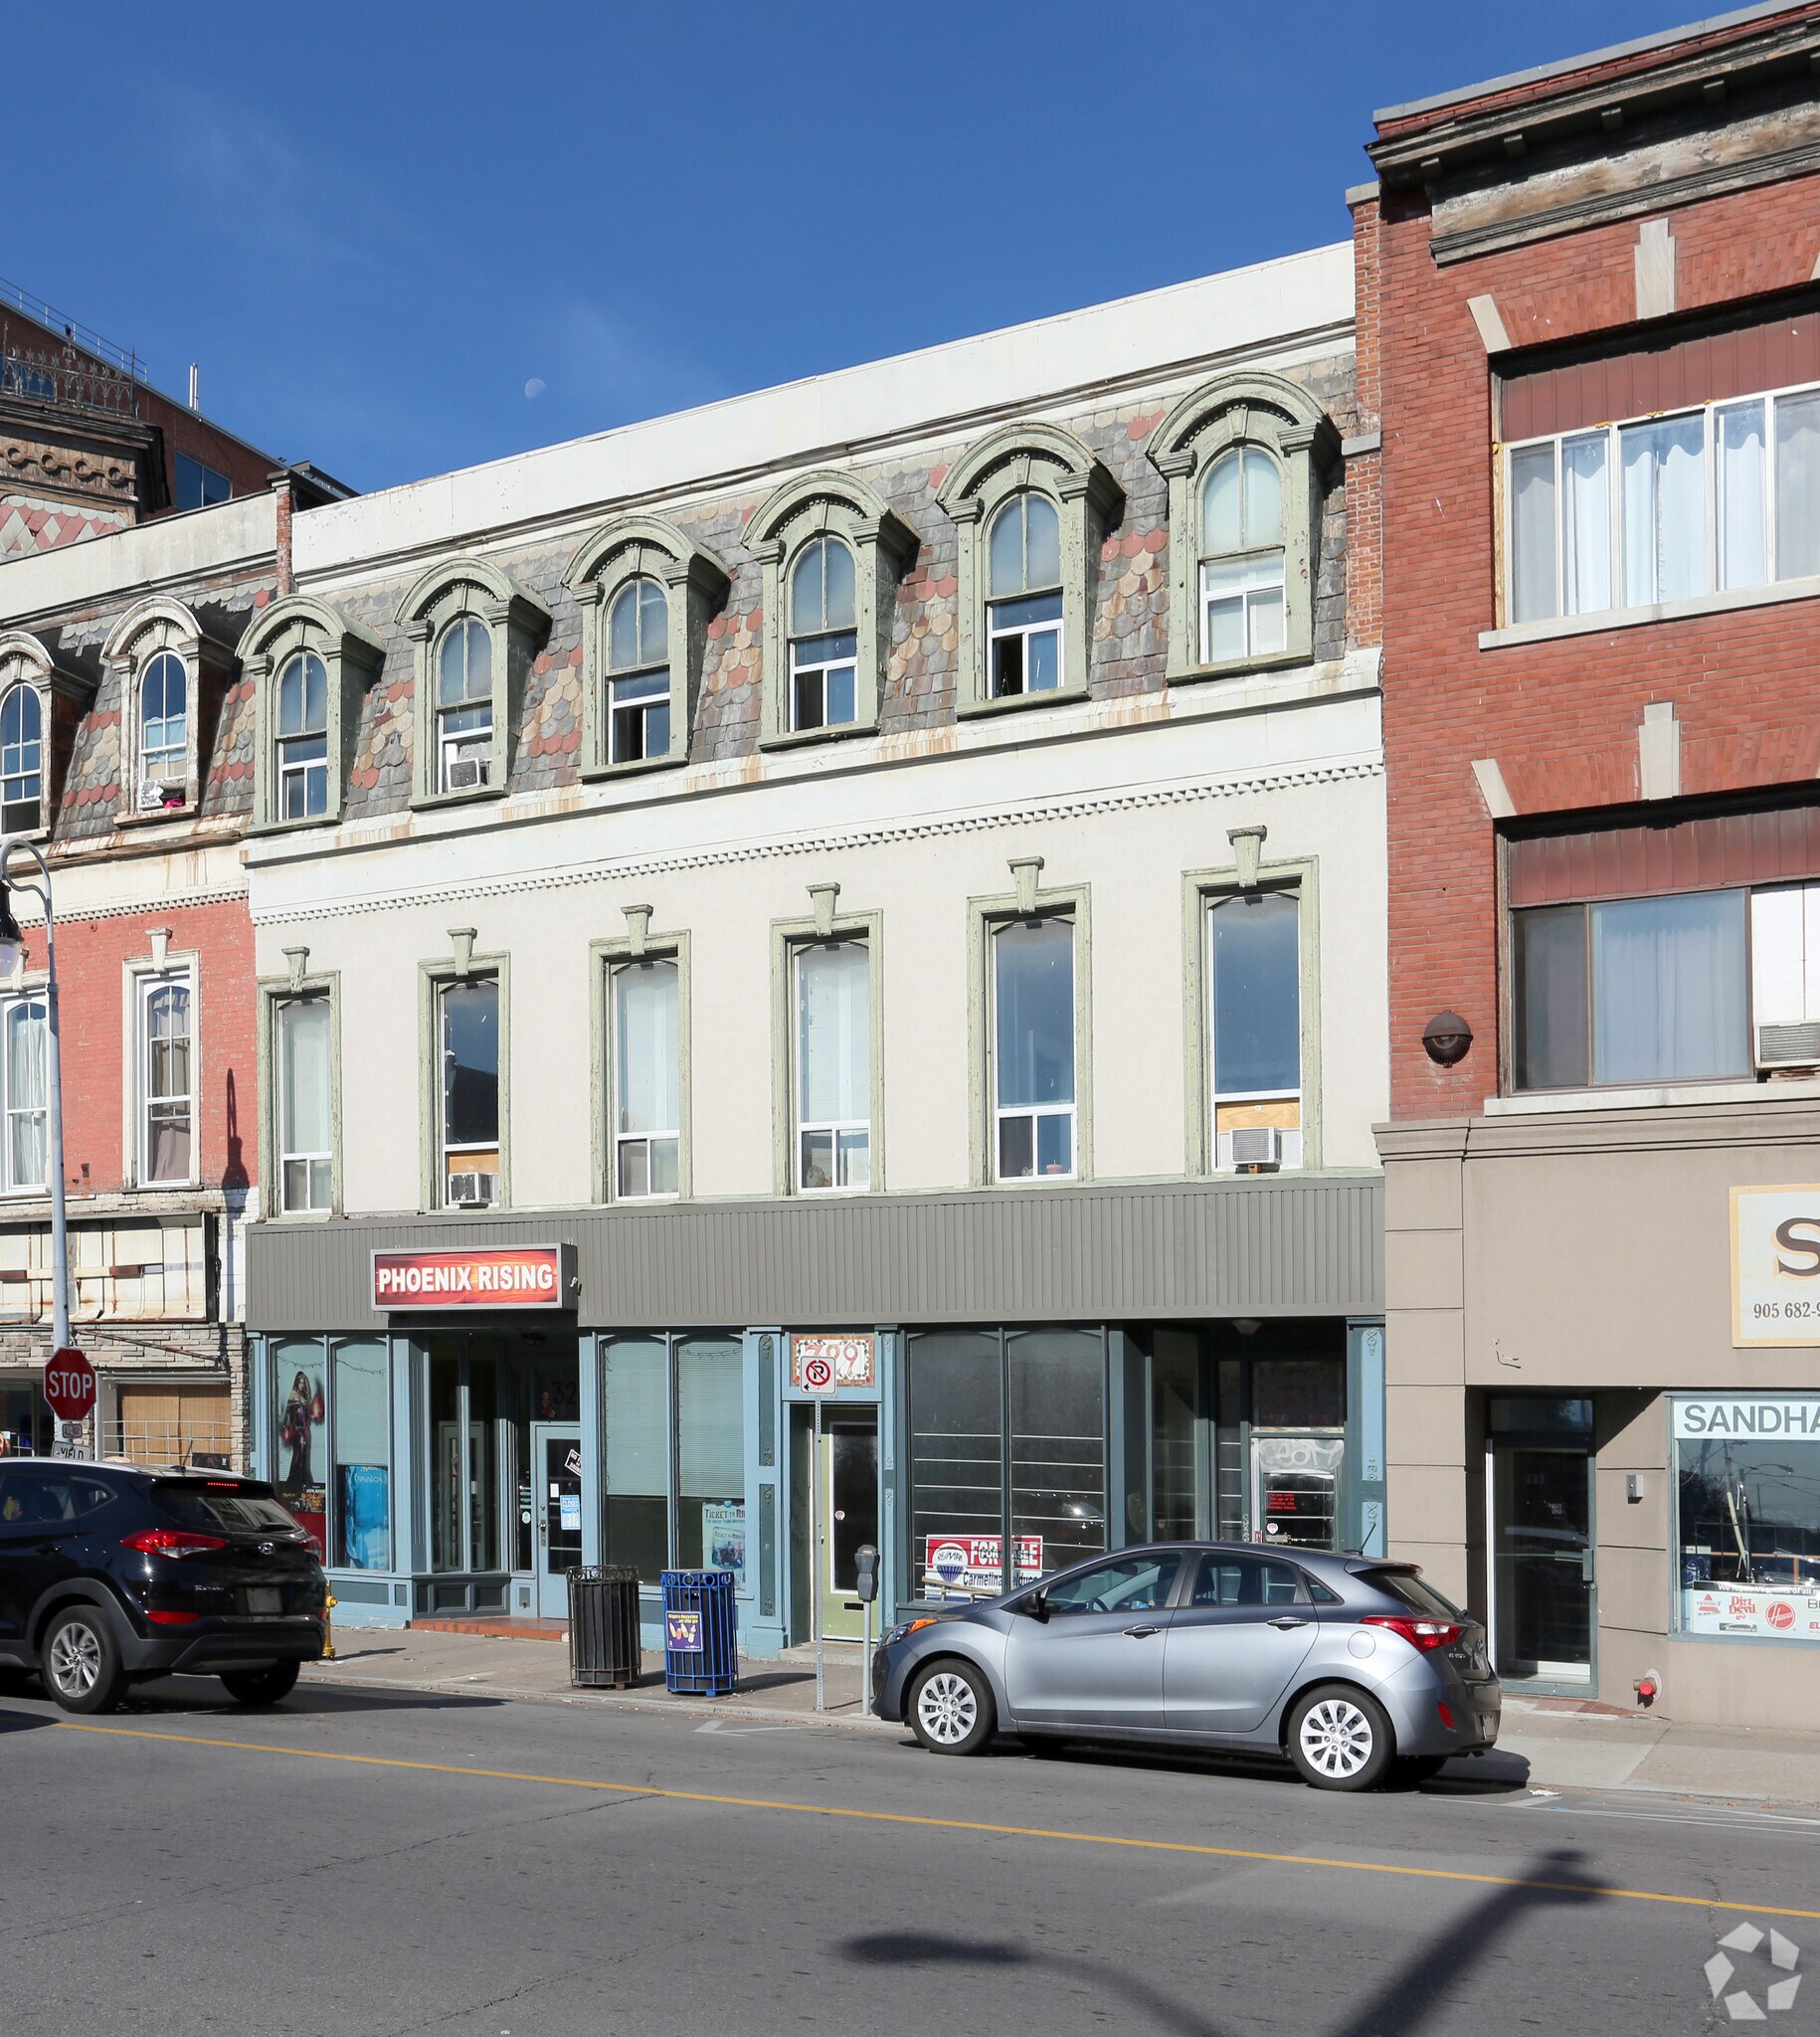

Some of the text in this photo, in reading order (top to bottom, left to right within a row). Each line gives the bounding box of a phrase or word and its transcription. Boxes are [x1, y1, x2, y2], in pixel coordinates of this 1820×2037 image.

[378, 1264, 553, 1293] PHOENIX RISING
[1753, 1303, 1780, 1319] 905
[49, 1371, 92, 1399] STOP
[938, 1552, 963, 1562] RE/MAX
[971, 1541, 999, 1565] FOR
[1729, 1604, 1756, 1614] Devil
